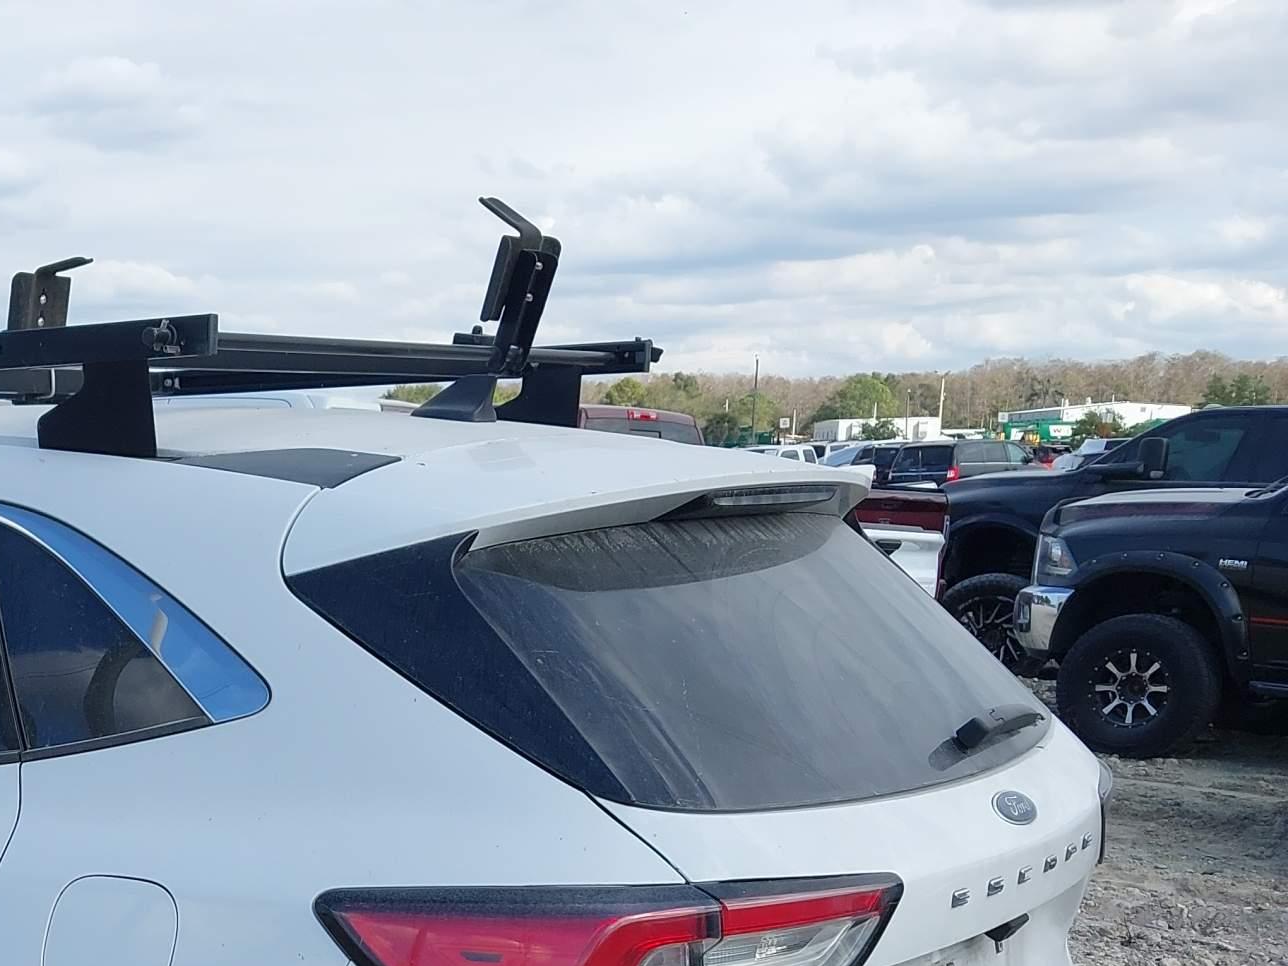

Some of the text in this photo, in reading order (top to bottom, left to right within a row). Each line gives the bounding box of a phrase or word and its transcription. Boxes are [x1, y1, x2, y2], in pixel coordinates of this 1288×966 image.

[1219, 558, 1248, 568] HEMI
[1004, 795, 1031, 816] Ford
[950, 831, 1093, 909] ESCAPE
